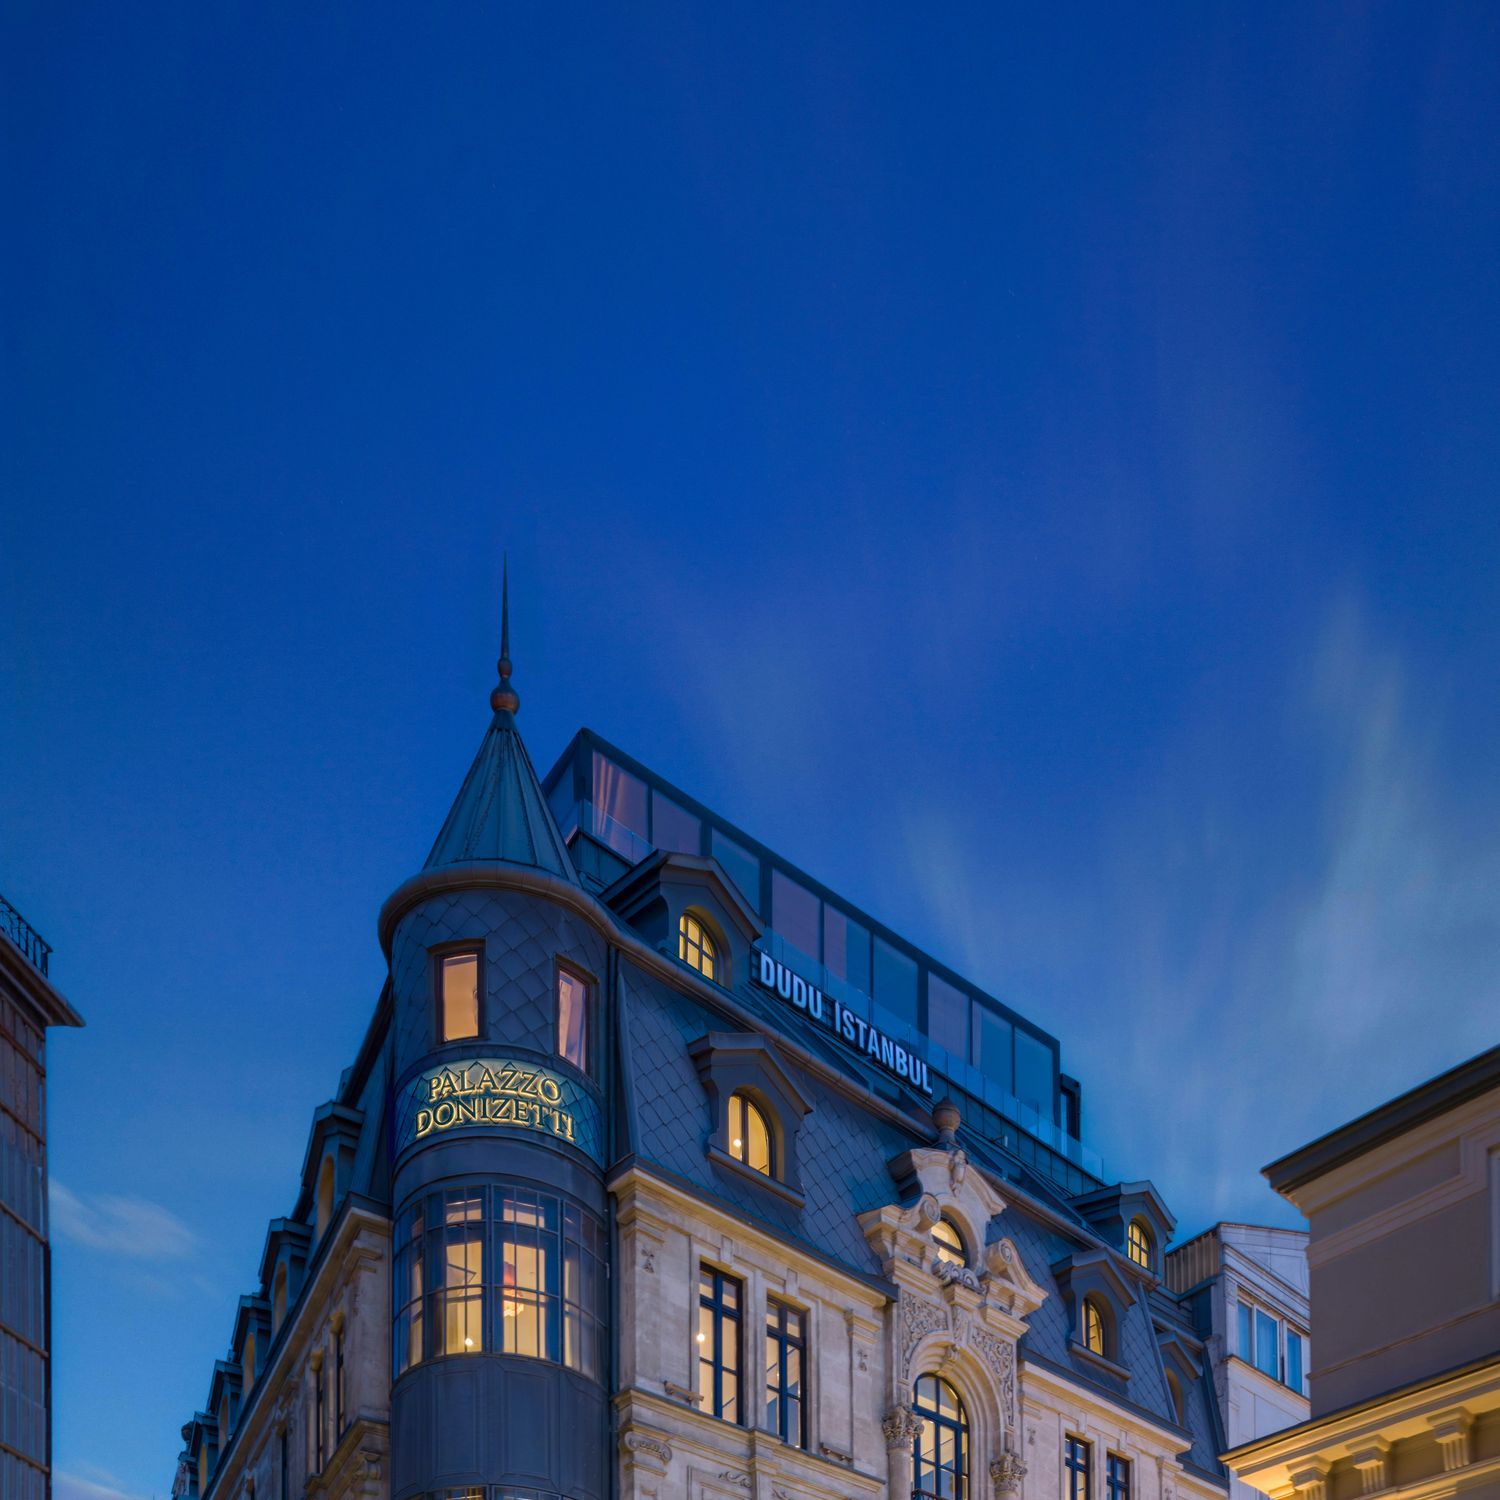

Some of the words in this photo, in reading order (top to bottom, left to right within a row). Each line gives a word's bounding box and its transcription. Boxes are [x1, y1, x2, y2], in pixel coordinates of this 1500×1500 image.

[760, 951, 823, 1020] DUDU
[834, 999, 933, 1094] ISTANBUL
[427, 1068, 562, 1103] PALAZZO
[415, 1097, 576, 1141] DONIZETTI
